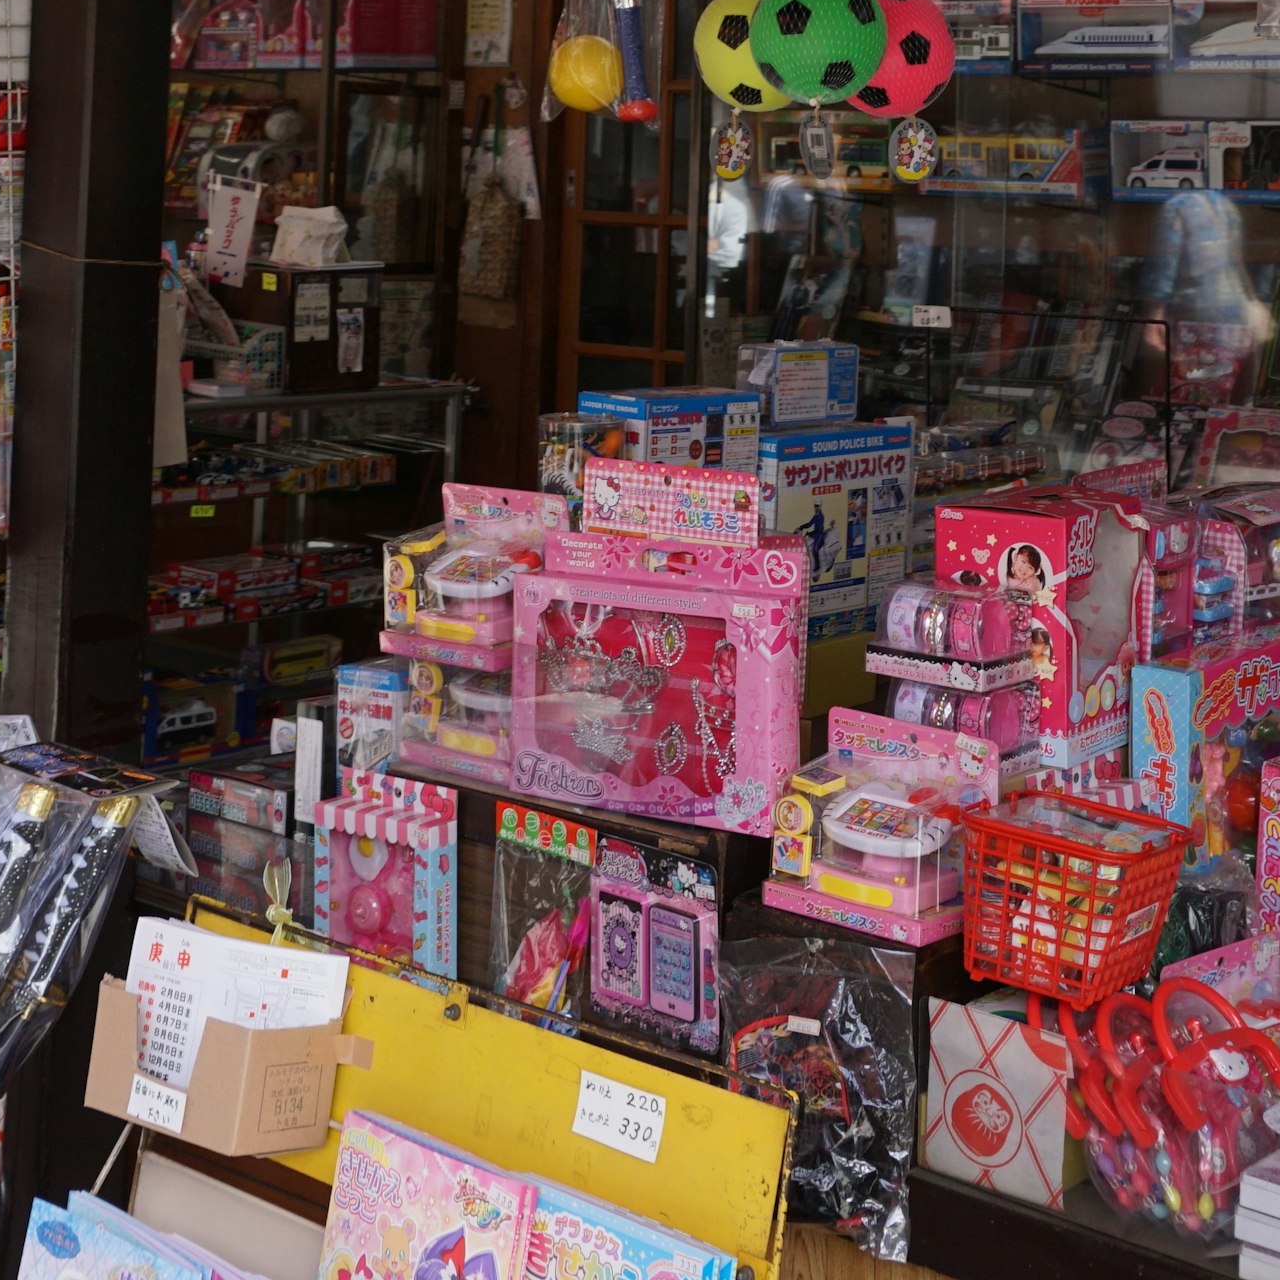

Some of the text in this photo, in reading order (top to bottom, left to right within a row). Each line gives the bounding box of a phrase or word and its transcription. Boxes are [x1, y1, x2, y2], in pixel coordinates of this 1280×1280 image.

[759, 441, 777, 454] BIKE
[812, 435, 885, 454] SOUND POLICE BIKE
[784, 453, 907, 487] サウンドポリスバイク
[672, 507, 742, 534] れいぞうこ
[1071, 516, 1096, 551] メル
[560, 537, 604, 552] Decorate
[570, 548, 593, 561] your
[566, 558, 596, 570] world
[1068, 547, 1096, 577] ちゃん
[569, 584, 704, 612] Create lots of different styles
[833, 729, 930, 761] タッチでレジスター
[516, 749, 605, 802] Fashion
[598, 849, 638, 869] おしゃべり
[805, 902, 885, 932] タッチでレジスター
[273, 1096, 304, 1117] B134
[339, 1147, 403, 1208] きせかえ
[554, 1215, 620, 1261] デラックス
